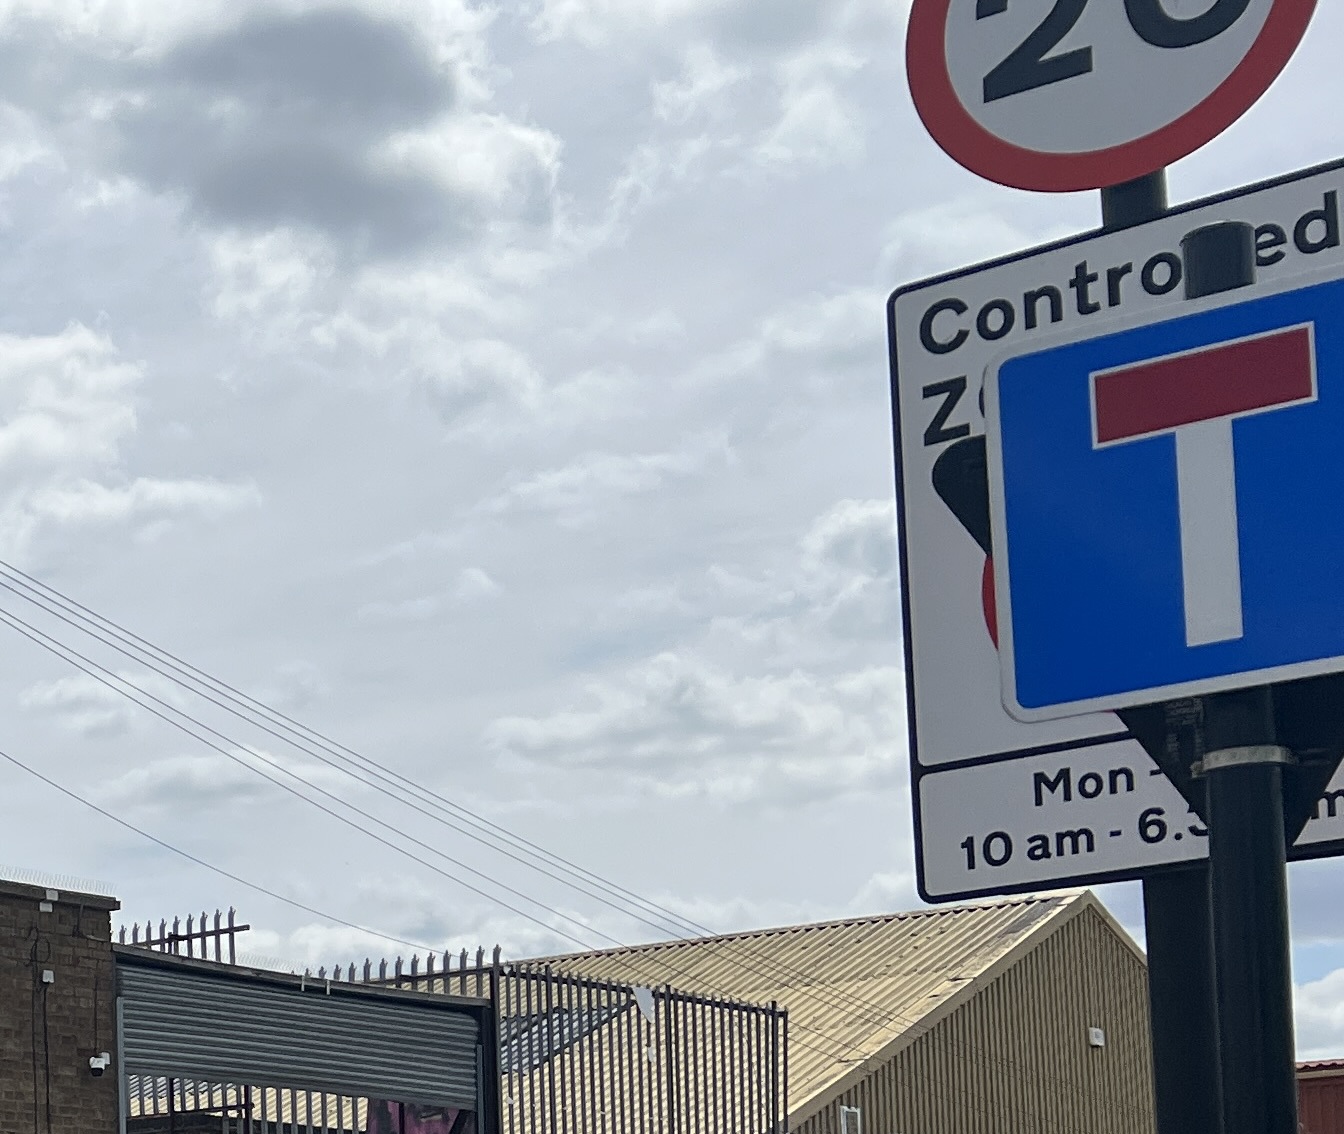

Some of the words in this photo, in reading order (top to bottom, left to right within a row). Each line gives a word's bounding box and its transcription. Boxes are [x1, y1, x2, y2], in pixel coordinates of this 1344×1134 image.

[919, 190, 1340, 354] Controed
[1033, 766, 1134, 807] Mon
[961, 831, 1012, 870] 10
[1027, 827, 1094, 861] am
